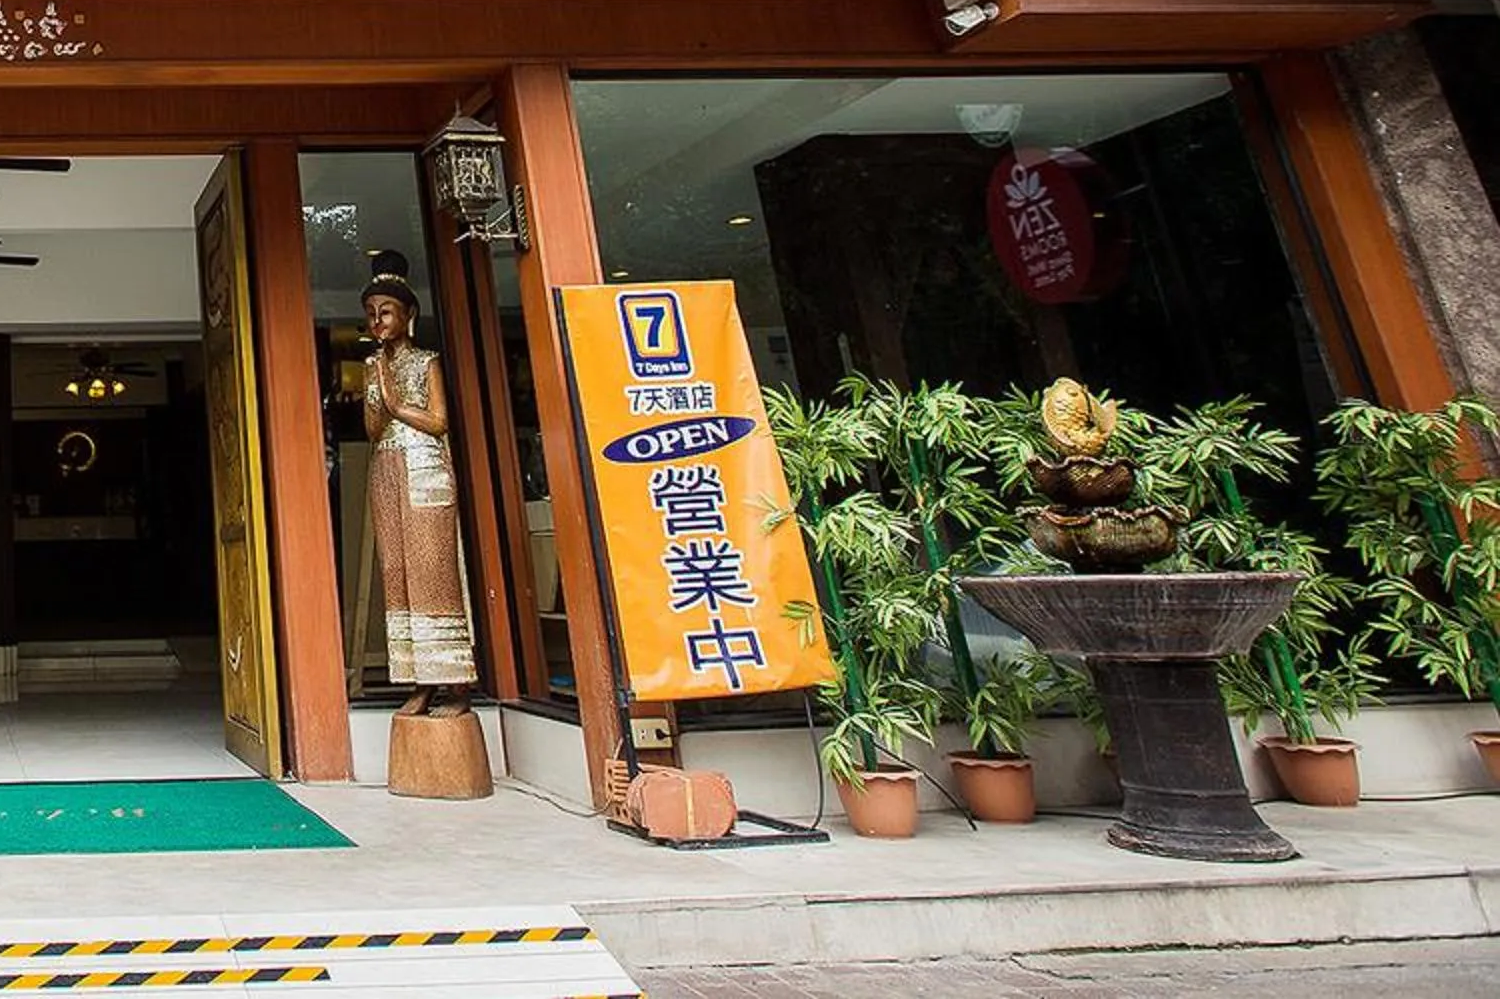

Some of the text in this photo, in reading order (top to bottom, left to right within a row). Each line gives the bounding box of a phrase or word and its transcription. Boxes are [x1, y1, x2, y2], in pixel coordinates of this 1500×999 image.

[635, 307, 665, 348] 7
[635, 361, 645, 374] 7
[645, 361, 669, 375] Days
[627, 384, 713, 412] 7天酒店
[626, 418, 731, 459] OPEN
[651, 466, 765, 690] 營業中
